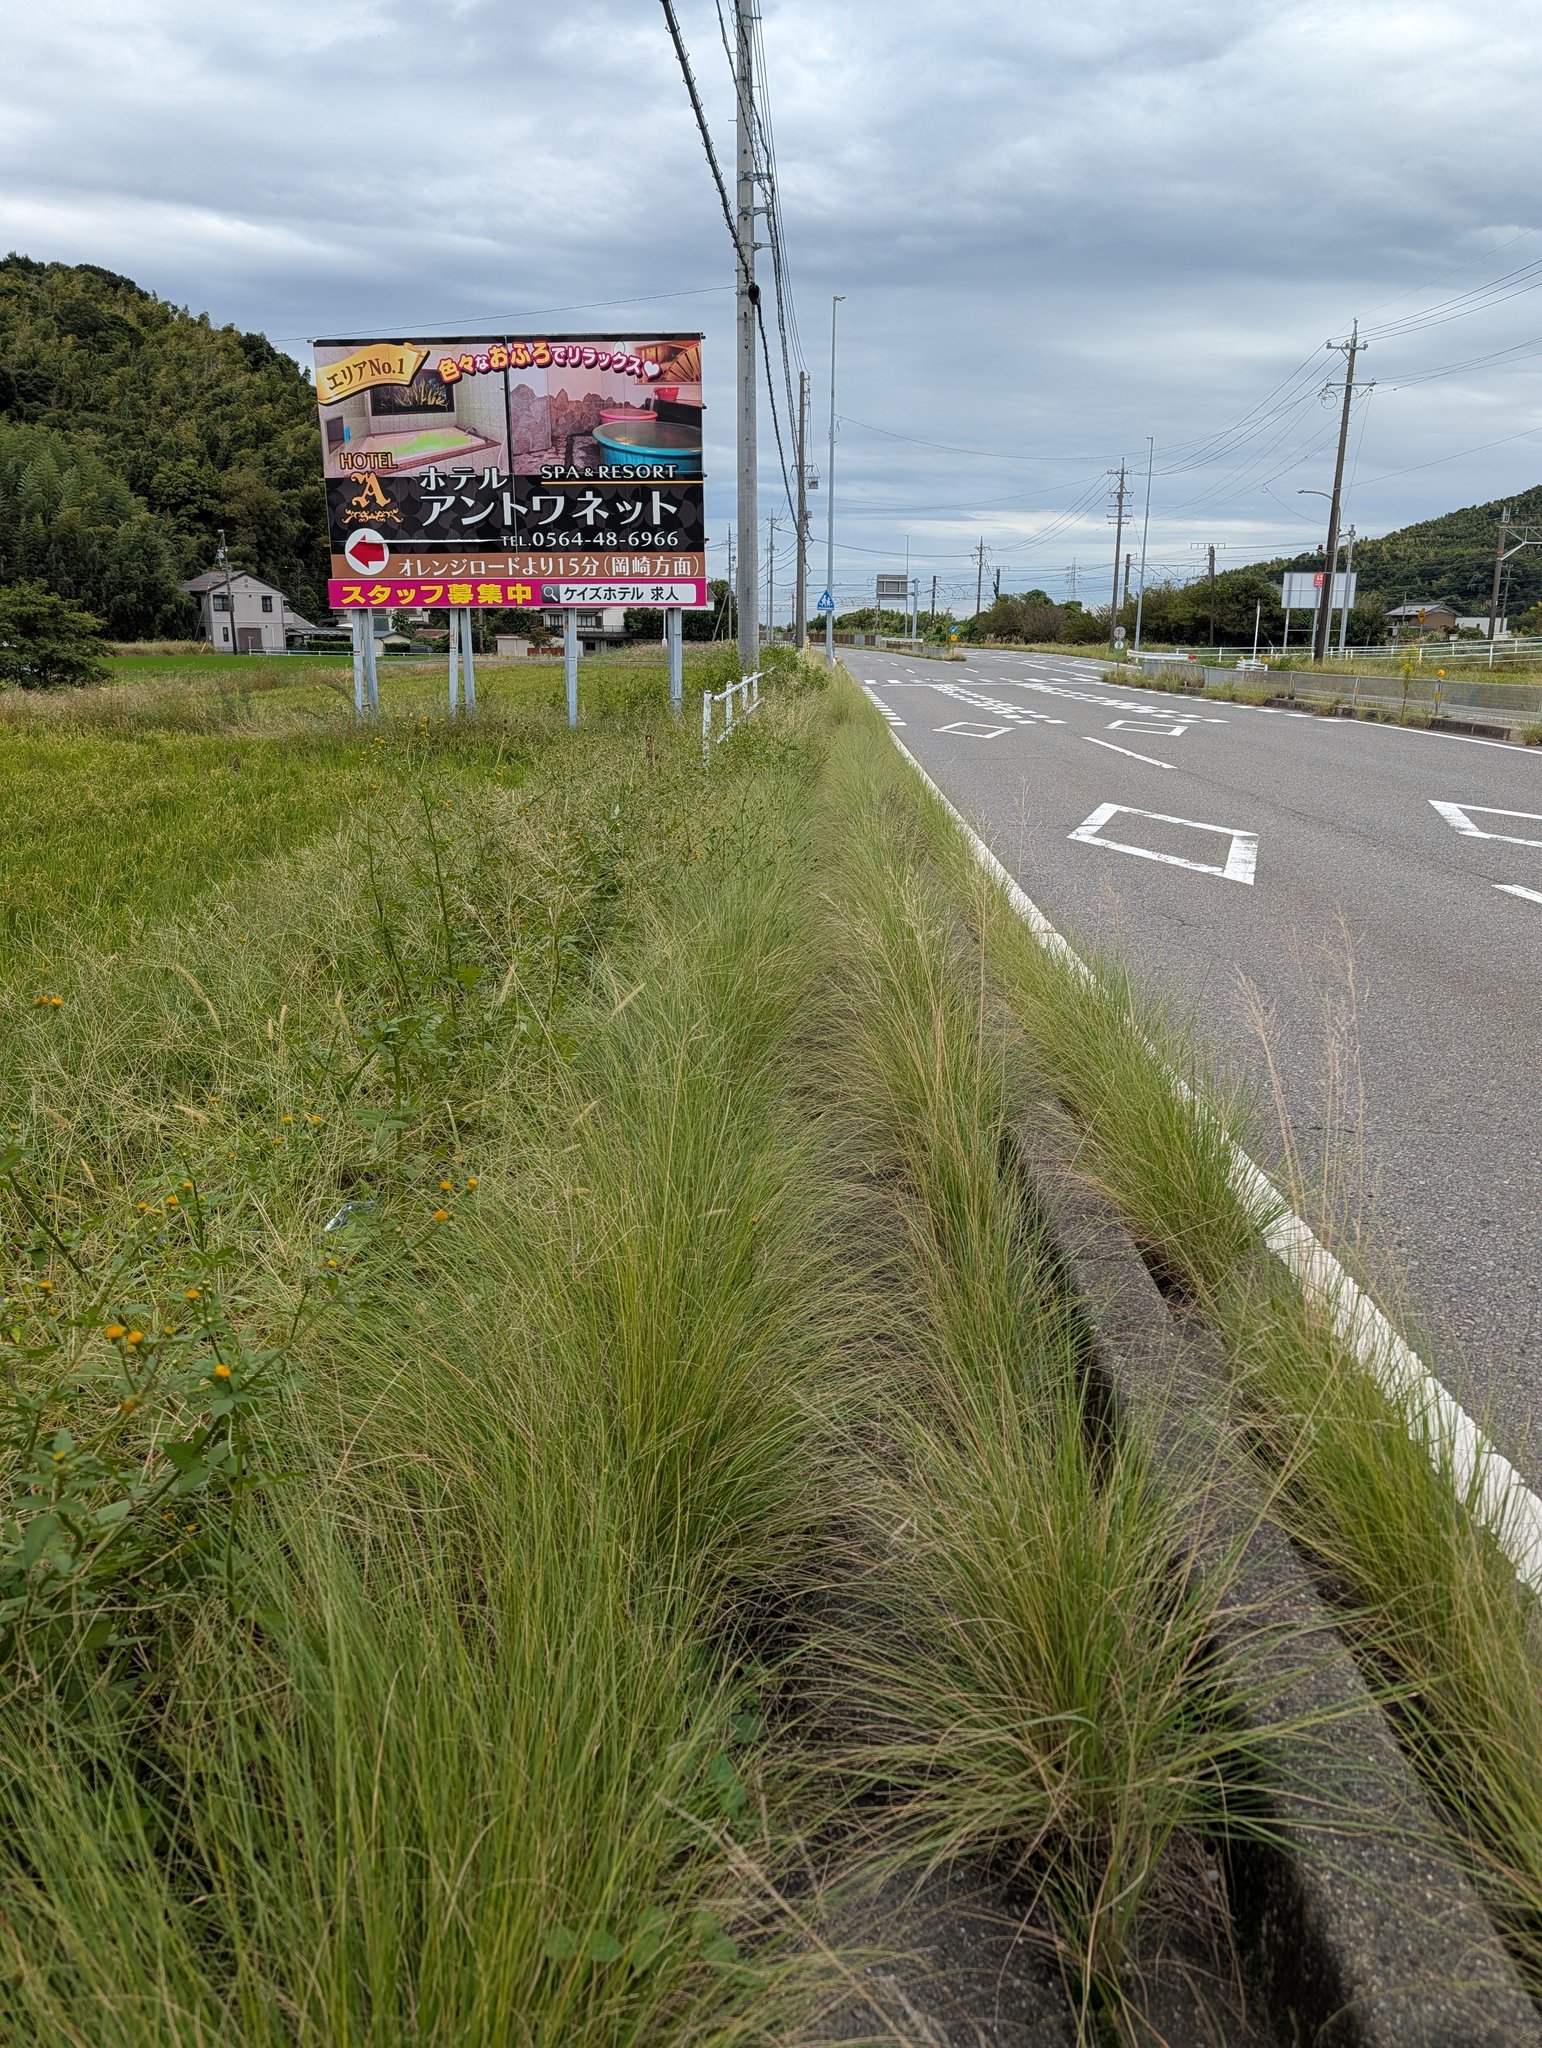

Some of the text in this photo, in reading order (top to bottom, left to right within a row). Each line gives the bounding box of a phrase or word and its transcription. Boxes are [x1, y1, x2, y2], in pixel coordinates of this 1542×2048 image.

[327, 357, 405, 391] エリアNo.1
[440, 341, 642, 383] 色々なおふろでリラックス
[340, 452, 397, 470] HOTEL
[541, 465, 677, 479] SPA & RESORT
[351, 472, 391, 508] A
[420, 467, 508, 491] ホテル
[420, 491, 677, 526] アントワネット
[341, 583, 532, 605] スタッフ募集中
[564, 587, 679, 601] ケイズホテル 求人
